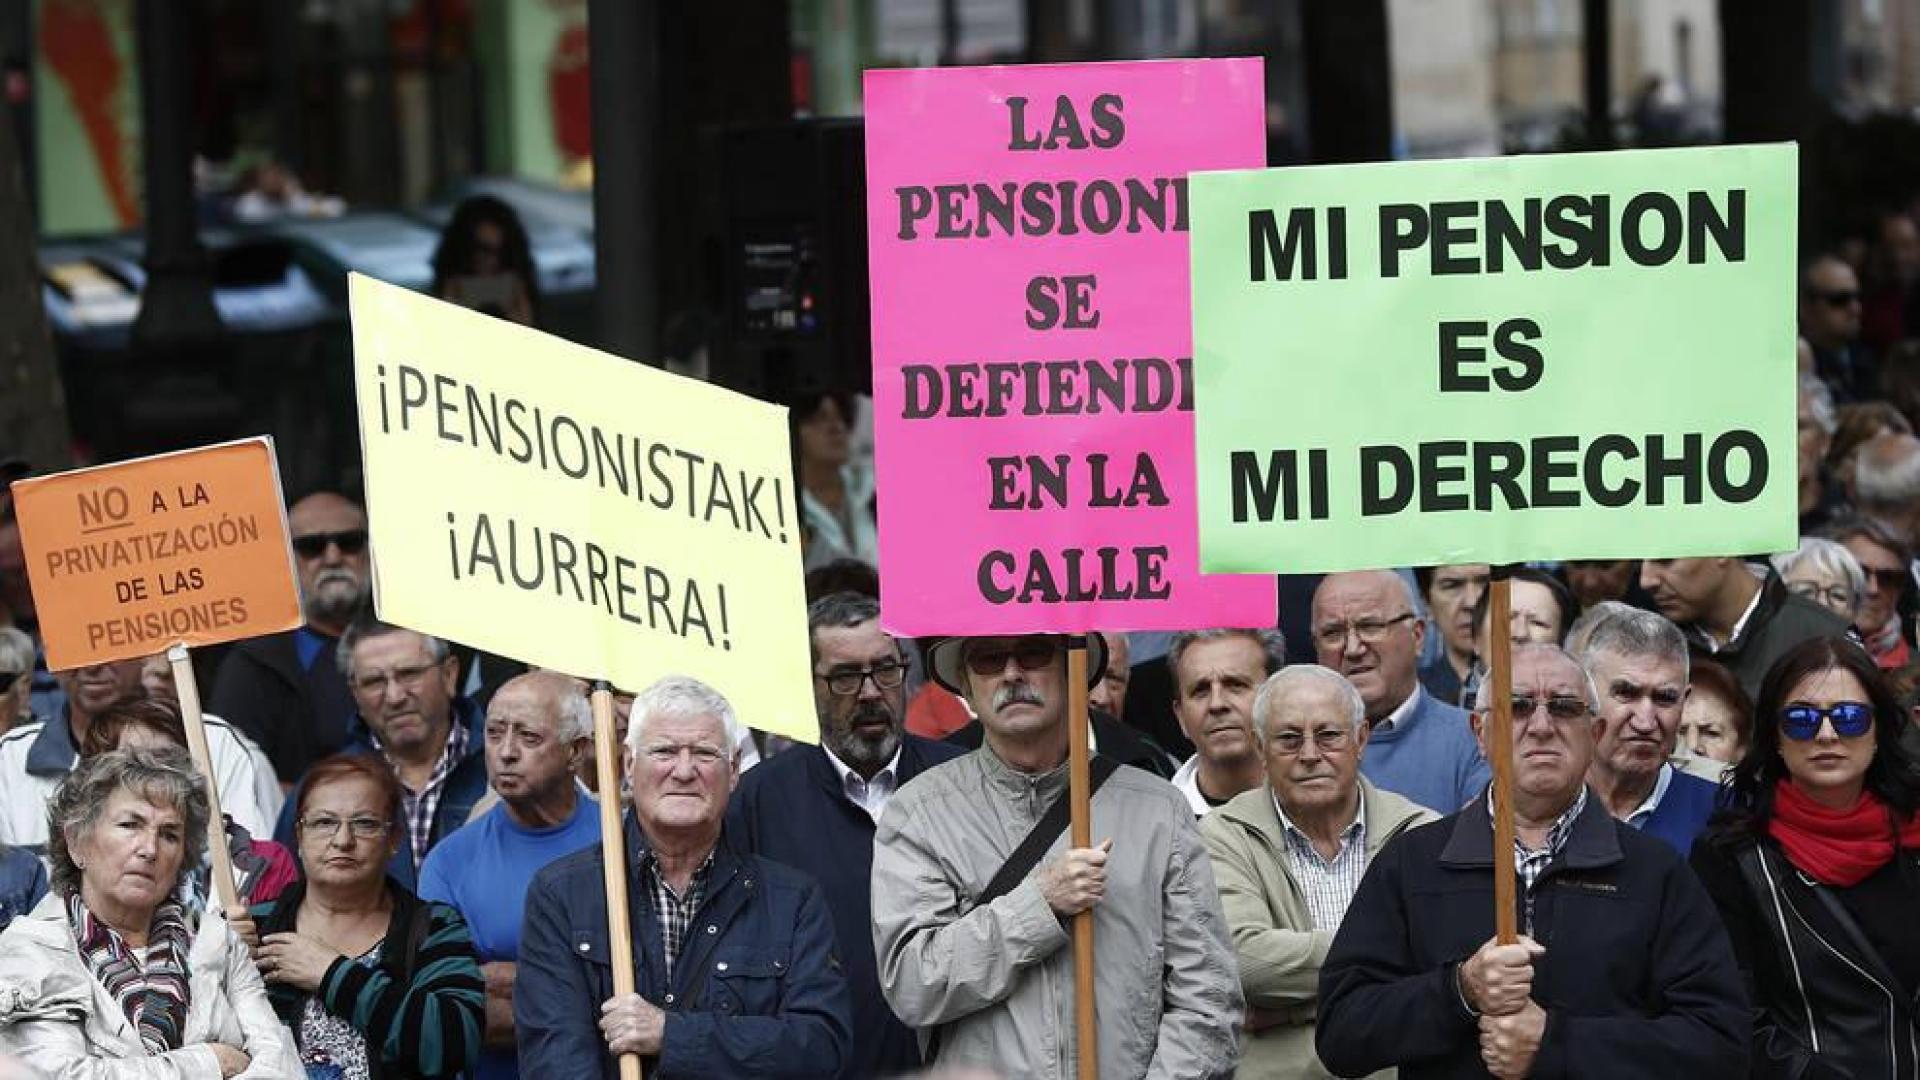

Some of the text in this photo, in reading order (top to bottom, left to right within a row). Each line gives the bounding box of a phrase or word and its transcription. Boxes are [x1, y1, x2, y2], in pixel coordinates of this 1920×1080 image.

[1005, 93, 1126, 152] LAS
[1248, 189, 1746, 282] MI PENSION
[1025, 274, 1101, 331] SE
[1438, 317, 1545, 393] ES
[377, 364, 788, 544] ¡PENSIONISTAK!
[987, 452, 1170, 511] EN LA
[1230, 429, 1770, 523] MI DERECHO
[77, 482, 210, 526] NO A LA
[46, 512, 259, 578] PRIVATIZACIÓN
[977, 544, 1172, 606] CALLE
[115, 567, 205, 604] DE LAS
[447, 511, 731, 651] ¡AURRERA!
[86, 596, 249, 650] PENSIONES
